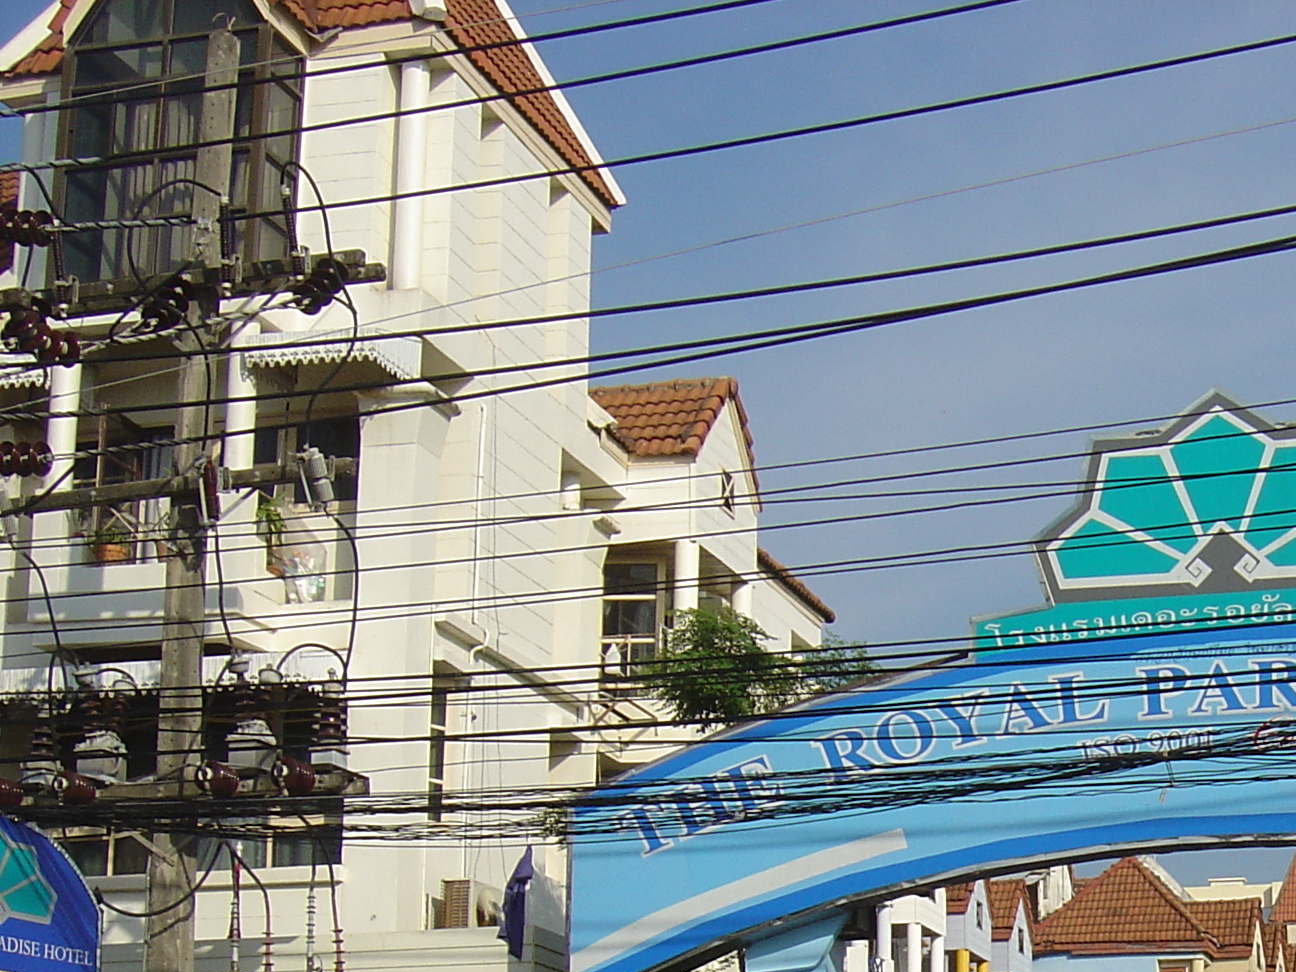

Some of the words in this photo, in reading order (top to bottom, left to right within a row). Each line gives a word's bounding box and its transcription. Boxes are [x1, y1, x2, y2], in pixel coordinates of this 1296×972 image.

[1077, 734, 1139, 759] ISO
[1148, 727, 1214, 753] 9001
[613, 754, 784, 858] THE
[810, 670, 1111, 786] ROYAL
[43, 943, 93, 966] HOTEL
